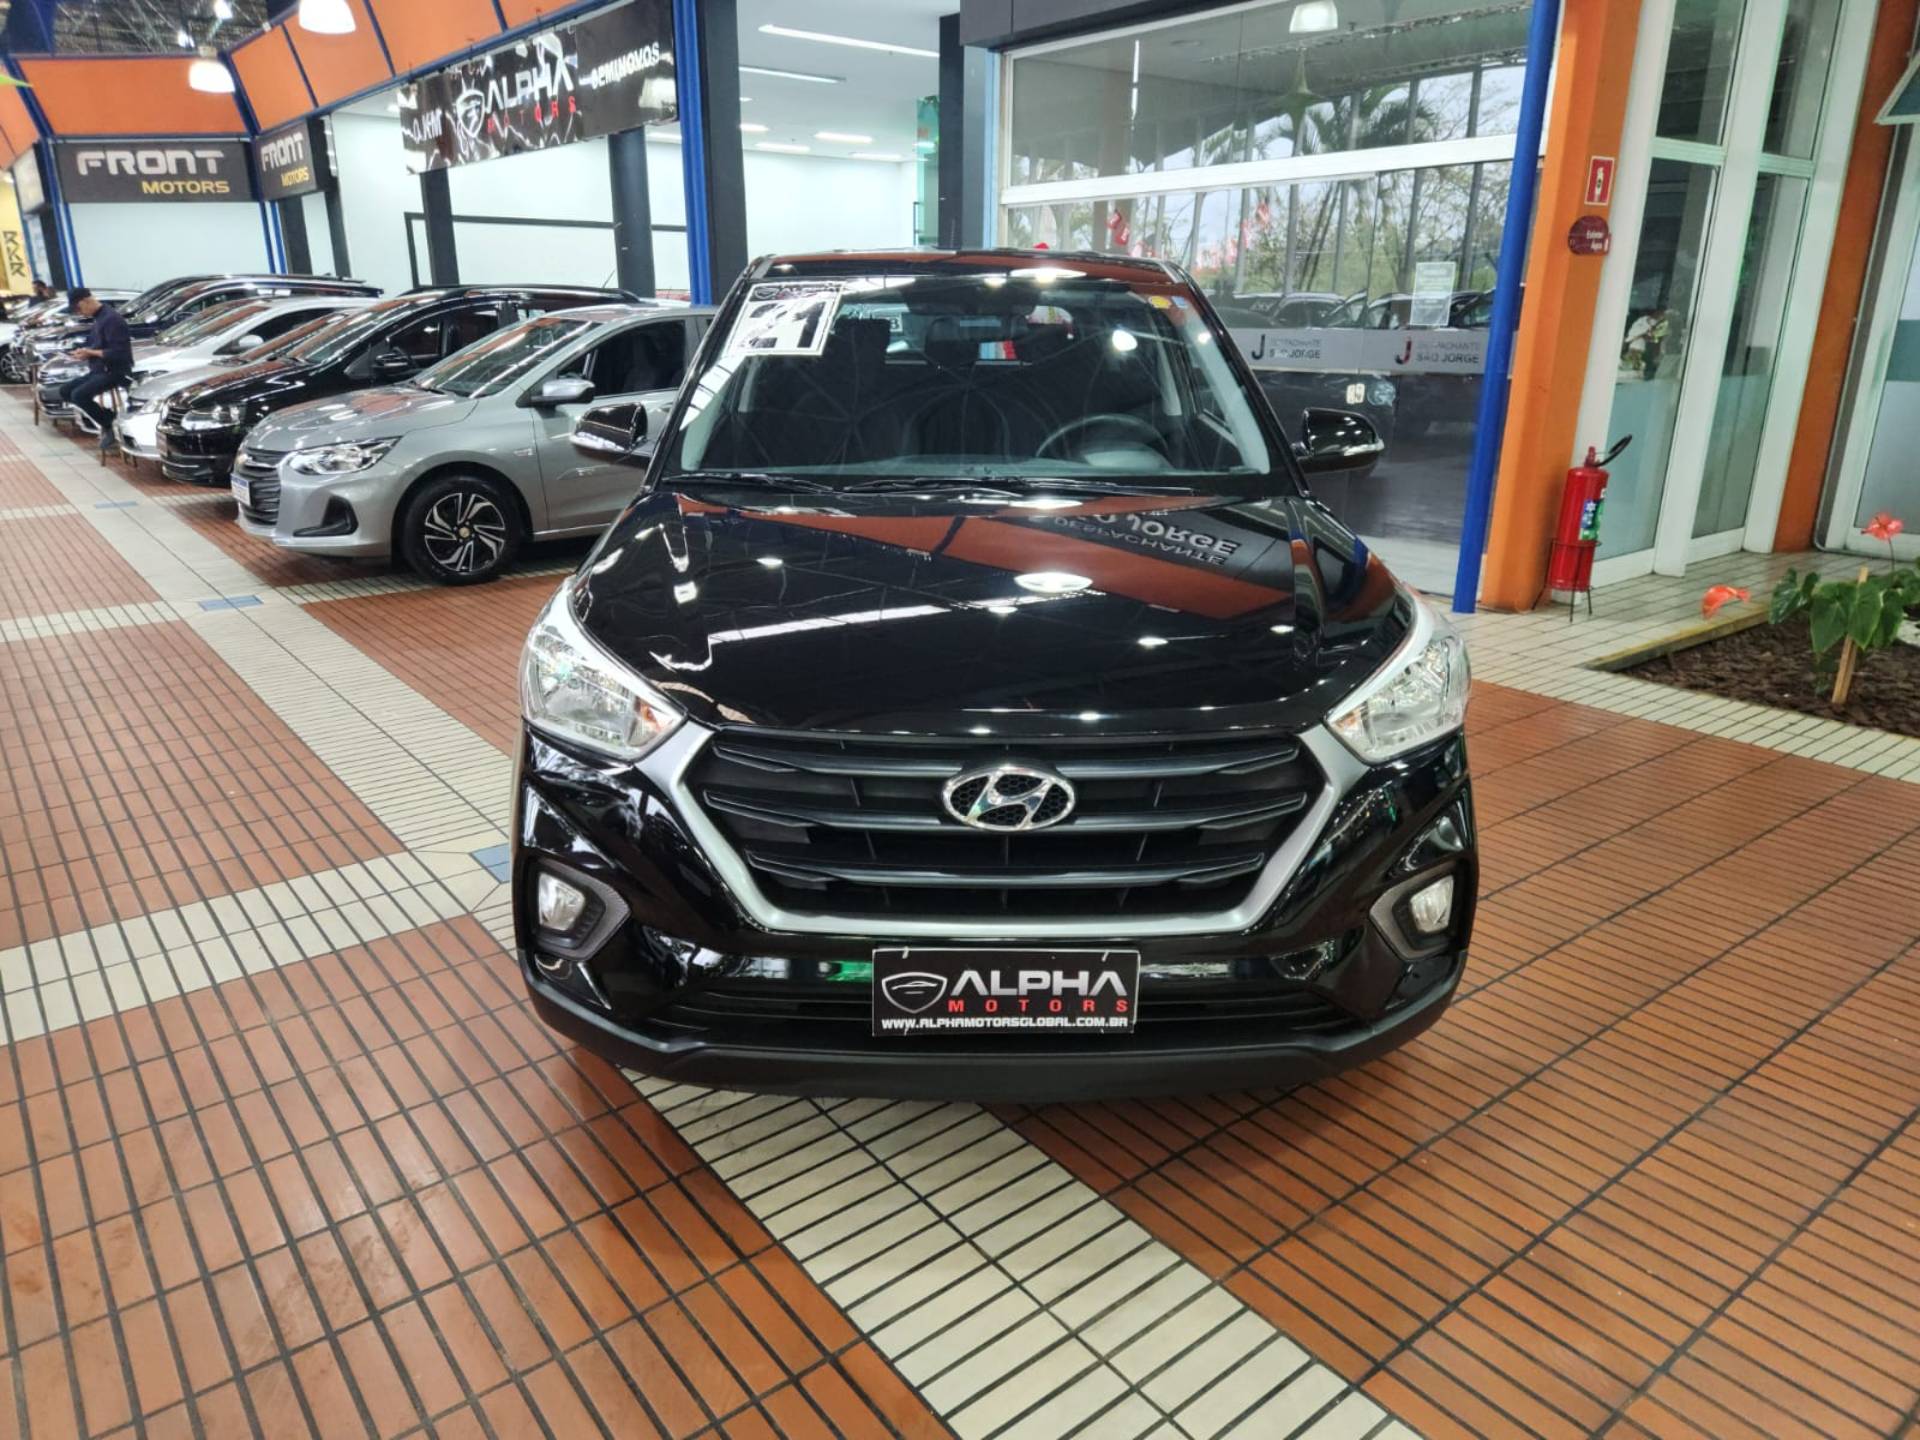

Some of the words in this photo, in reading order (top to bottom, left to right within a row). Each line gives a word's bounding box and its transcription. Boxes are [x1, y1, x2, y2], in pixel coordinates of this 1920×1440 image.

[485, 54, 574, 113] ALPHA
[261, 133, 305, 172] FRONT
[76, 150, 225, 176] FRONT
[141, 180, 231, 194] MOTORS
[281, 167, 310, 187] MOTORS
[1441, 352, 1480, 364] JORGE
[950, 970, 1128, 996] ALPHA
[948, 999, 1129, 1012] MOTORS
[881, 1016, 1128, 1029] WWW.ALPHAMOTORSGLOBAL.COM.BR
